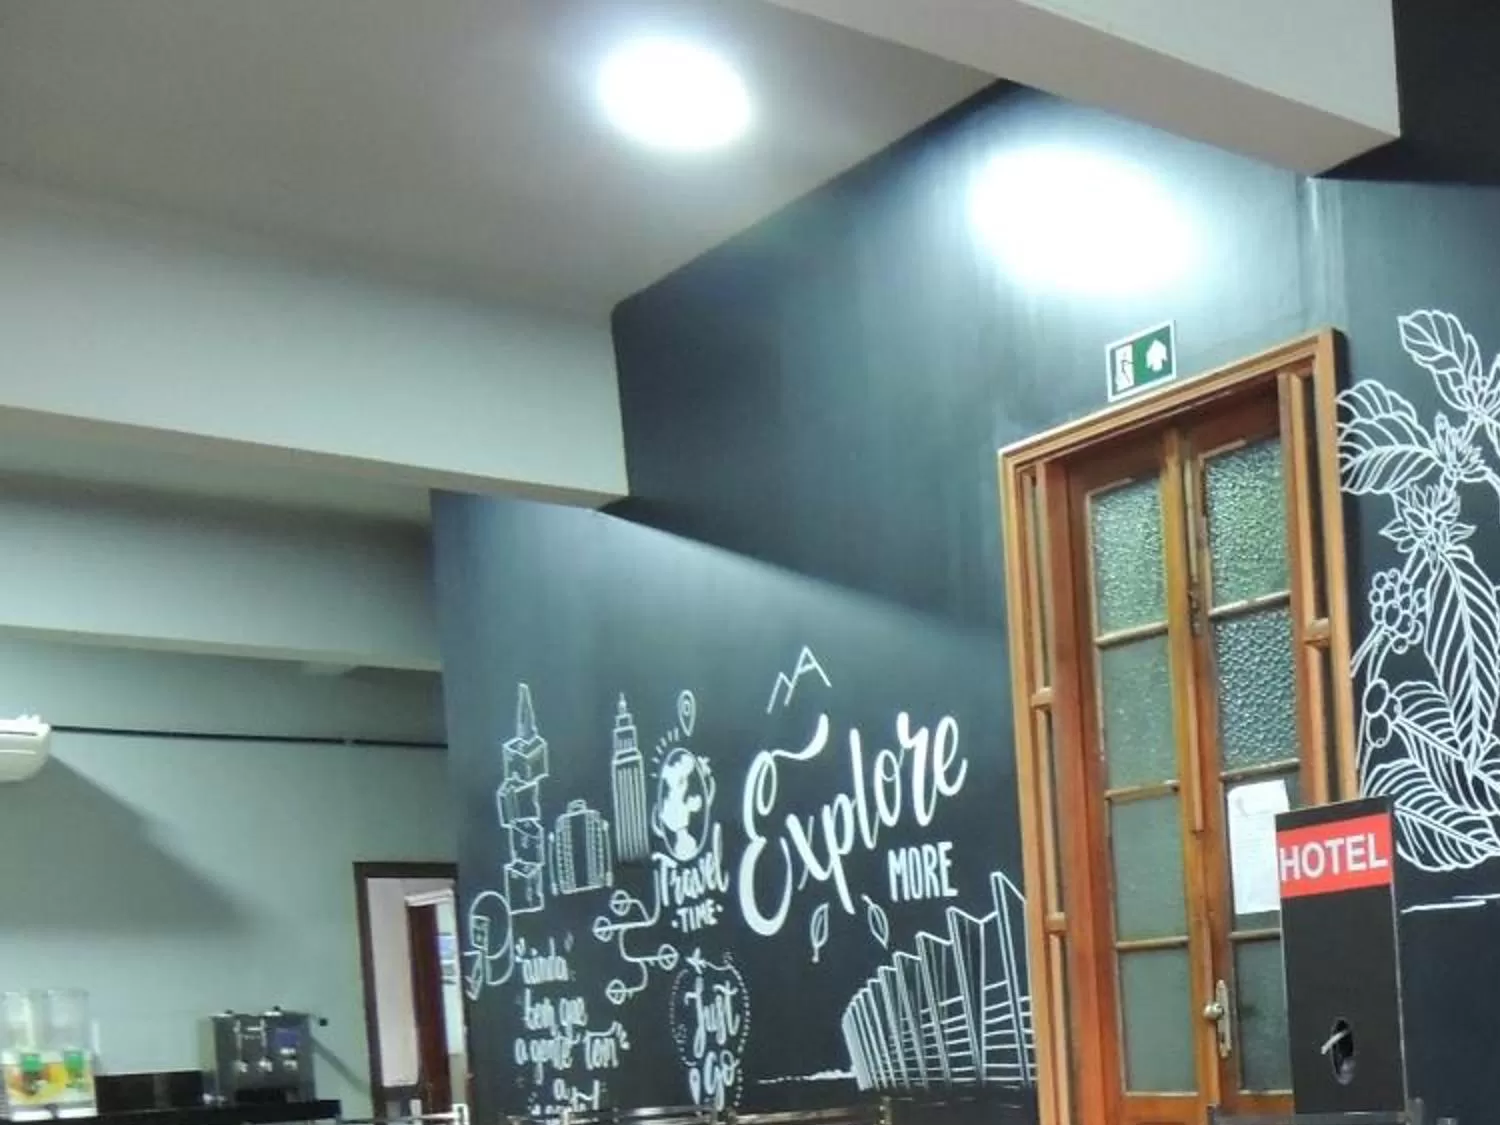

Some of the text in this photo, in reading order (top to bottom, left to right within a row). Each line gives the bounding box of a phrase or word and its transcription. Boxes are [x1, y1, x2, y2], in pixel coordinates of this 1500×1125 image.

[739, 711, 968, 936] Explore
[1279, 831, 1390, 882] HOTEL
[652, 822, 729, 907] Travel
[888, 841, 959, 902] MORE
